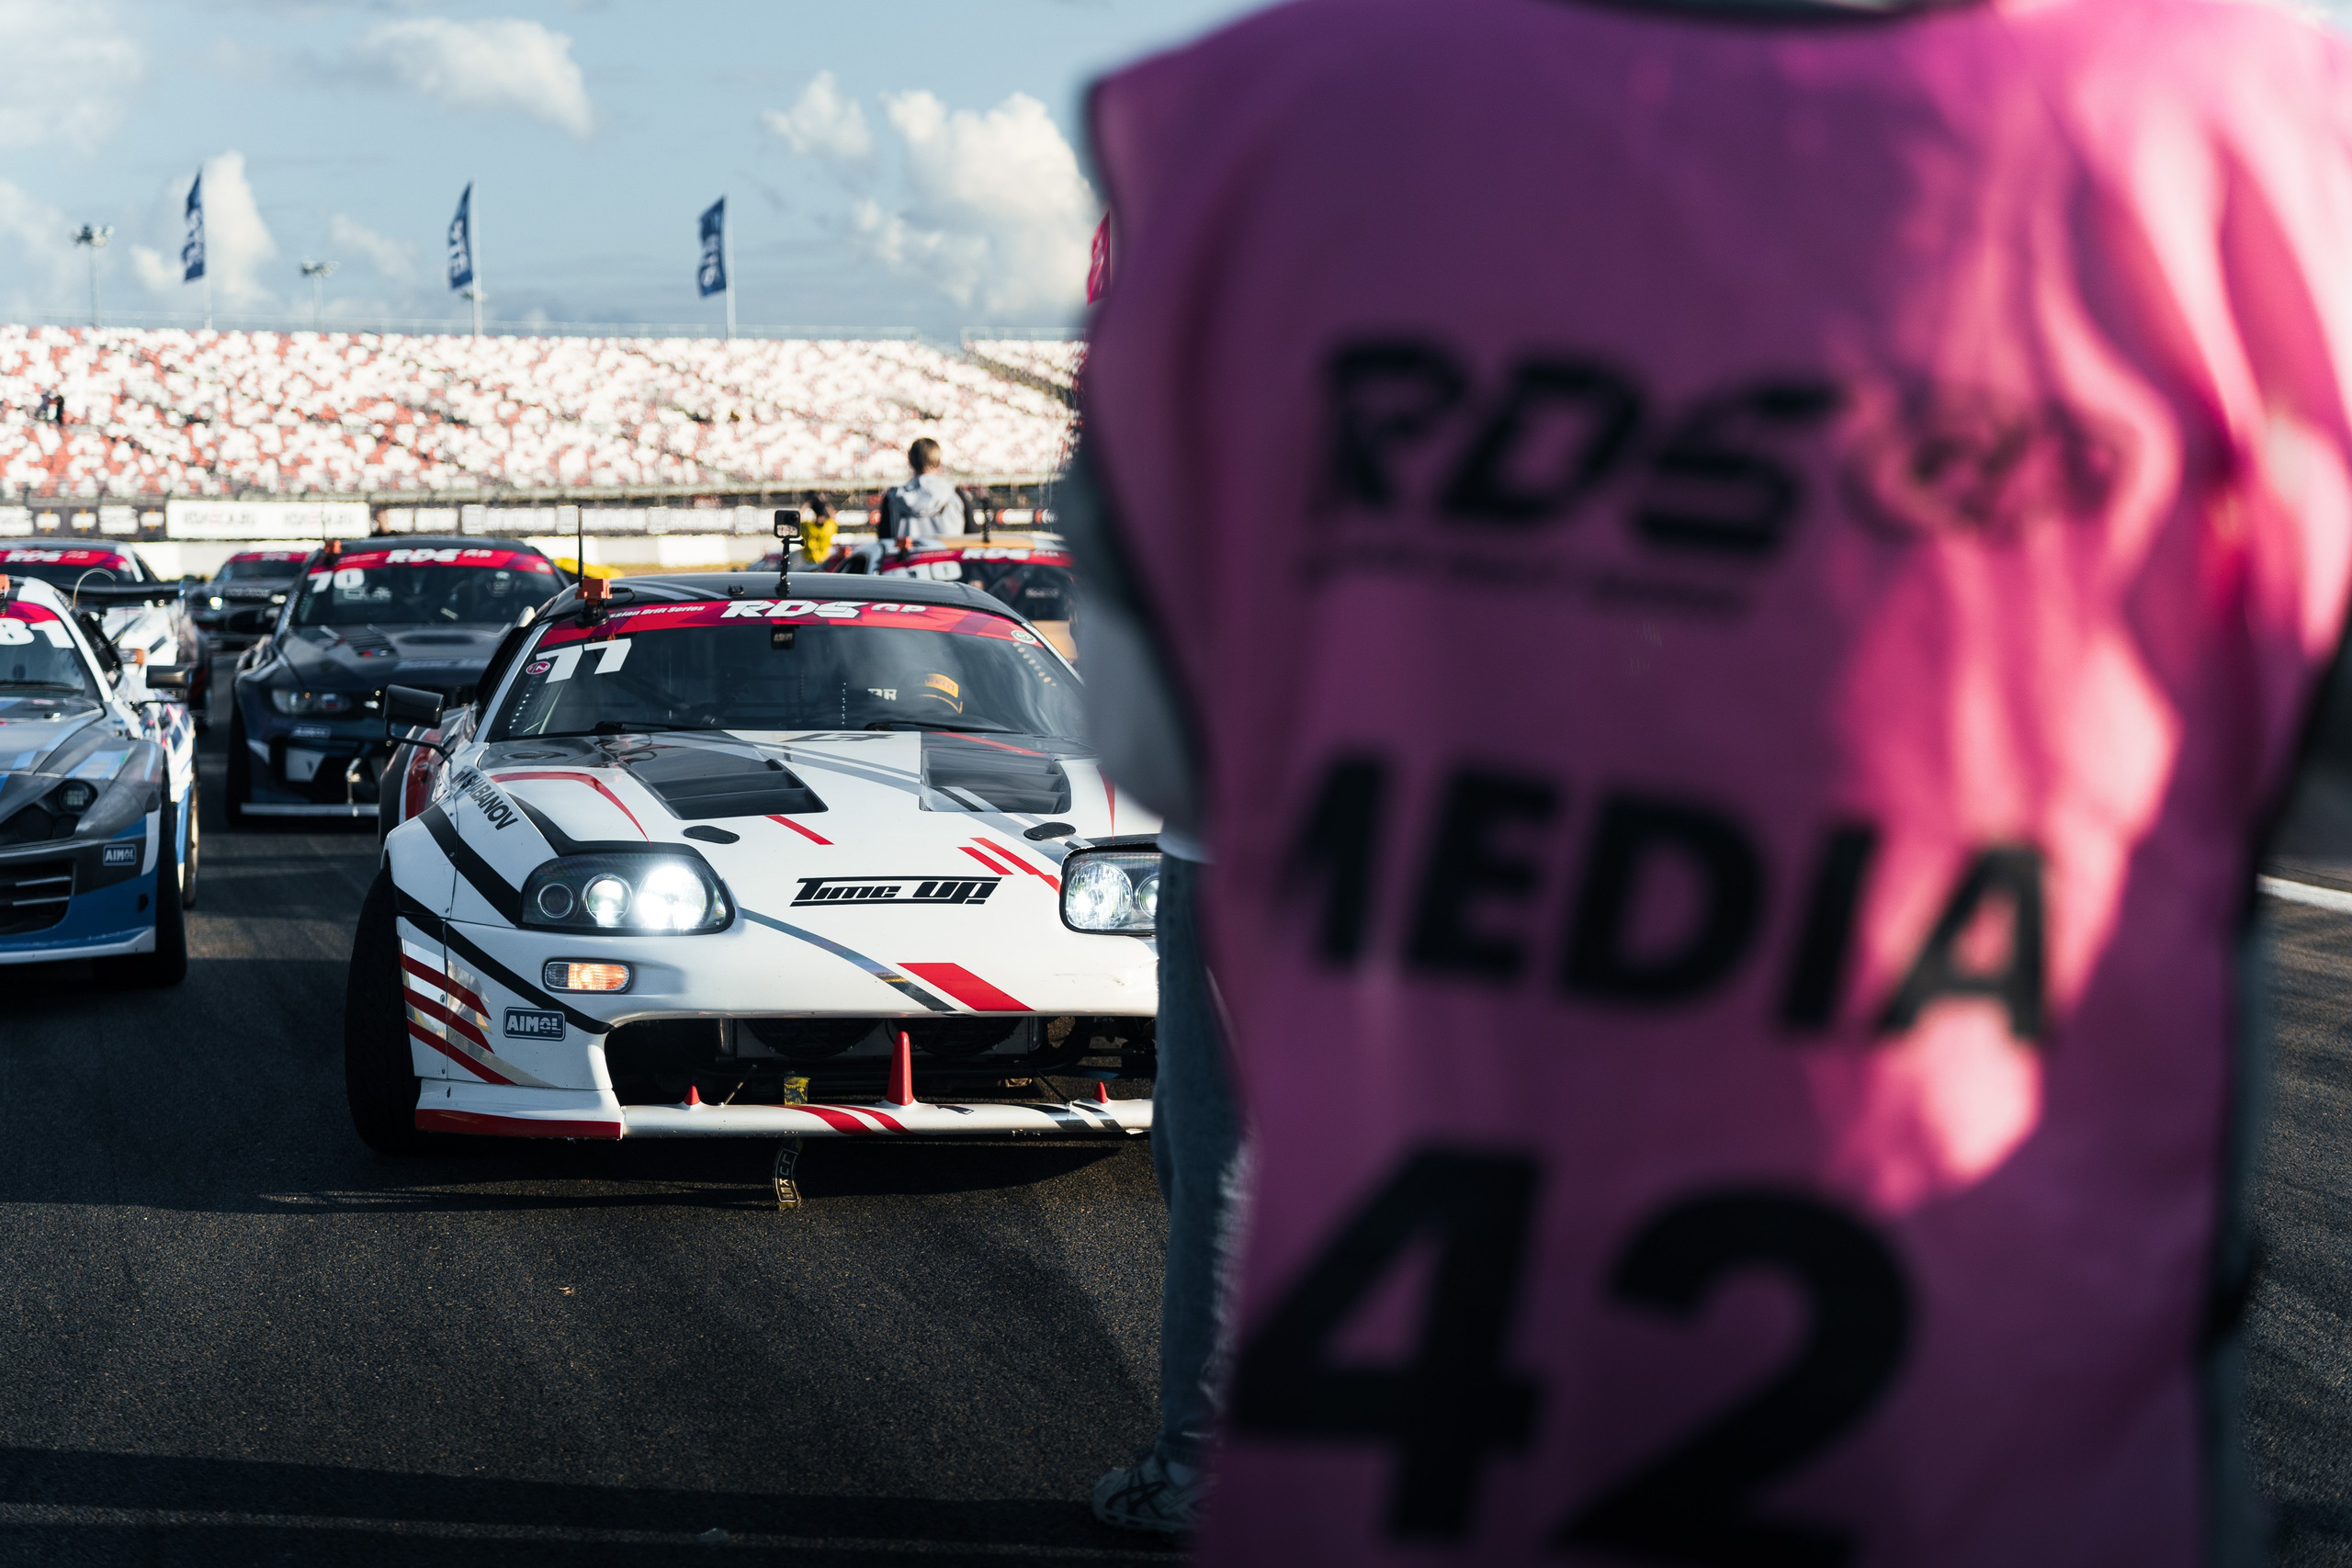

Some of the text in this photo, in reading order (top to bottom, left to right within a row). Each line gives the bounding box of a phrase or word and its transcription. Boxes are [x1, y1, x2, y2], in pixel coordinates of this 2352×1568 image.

[1319, 340, 1843, 562] RDS
[386, 548, 462, 563] RDS
[960, 548, 1030, 559] RDS
[307, 568, 365, 593] 70
[640, 607, 669, 615] Drift
[720, 600, 869, 618] RDS
[871, 603, 926, 613] GP
[536, 637, 632, 684] 77
[105, 849, 135, 862] AIMOL
[506, 1015, 561, 1033] AIMOL
[1227, 1145, 1922, 1568] 42
